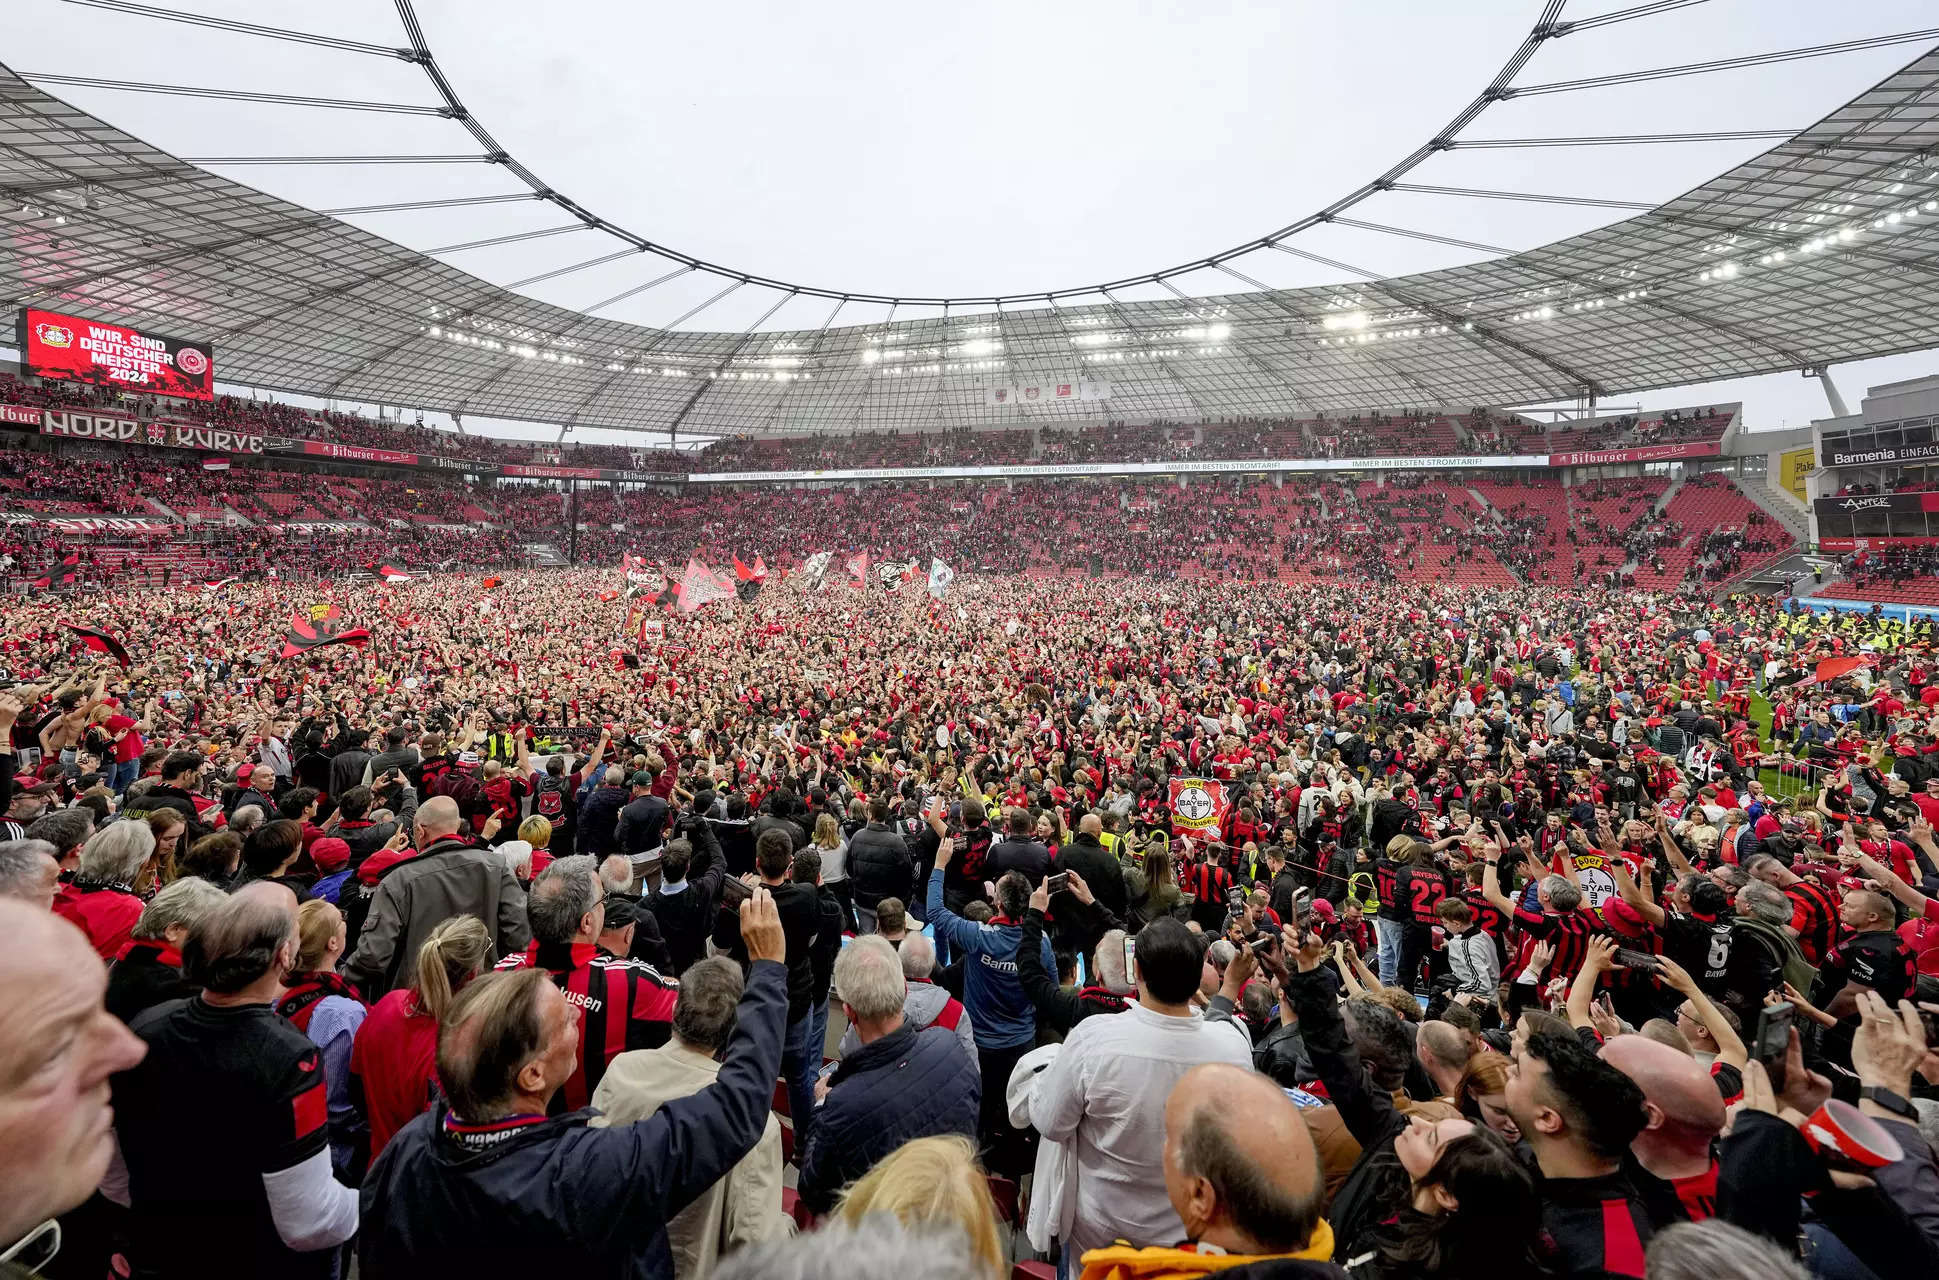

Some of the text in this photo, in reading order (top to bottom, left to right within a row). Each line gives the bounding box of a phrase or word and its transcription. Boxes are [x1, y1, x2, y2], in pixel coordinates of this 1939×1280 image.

[88, 326, 127, 345] WIR.
[130, 335, 166, 352] SIND
[80, 337, 174, 366] DEUTSCHER
[91, 352, 165, 375] MEISTER.
[109, 368, 149, 385] 2024
[44, 411, 138, 440] NORD
[149, 436, 165, 446] 04
[176, 427, 263, 454] KURVE
[333, 444, 375, 460] Bitburger
[1571, 451, 1628, 465] Bitburger
[1834, 449, 1896, 465] Barmenia
[1394, 459, 1424, 467] BESTEN
[1427, 458, 1482, 466] STROMTARIF!
[1796, 461, 1816, 473] Plaka
[1175, 815, 1218, 827] Leverkusen
[1410, 879, 1447, 917] 22
[1707, 933, 1733, 969] 6
[1851, 968, 1873, 981] trivo
